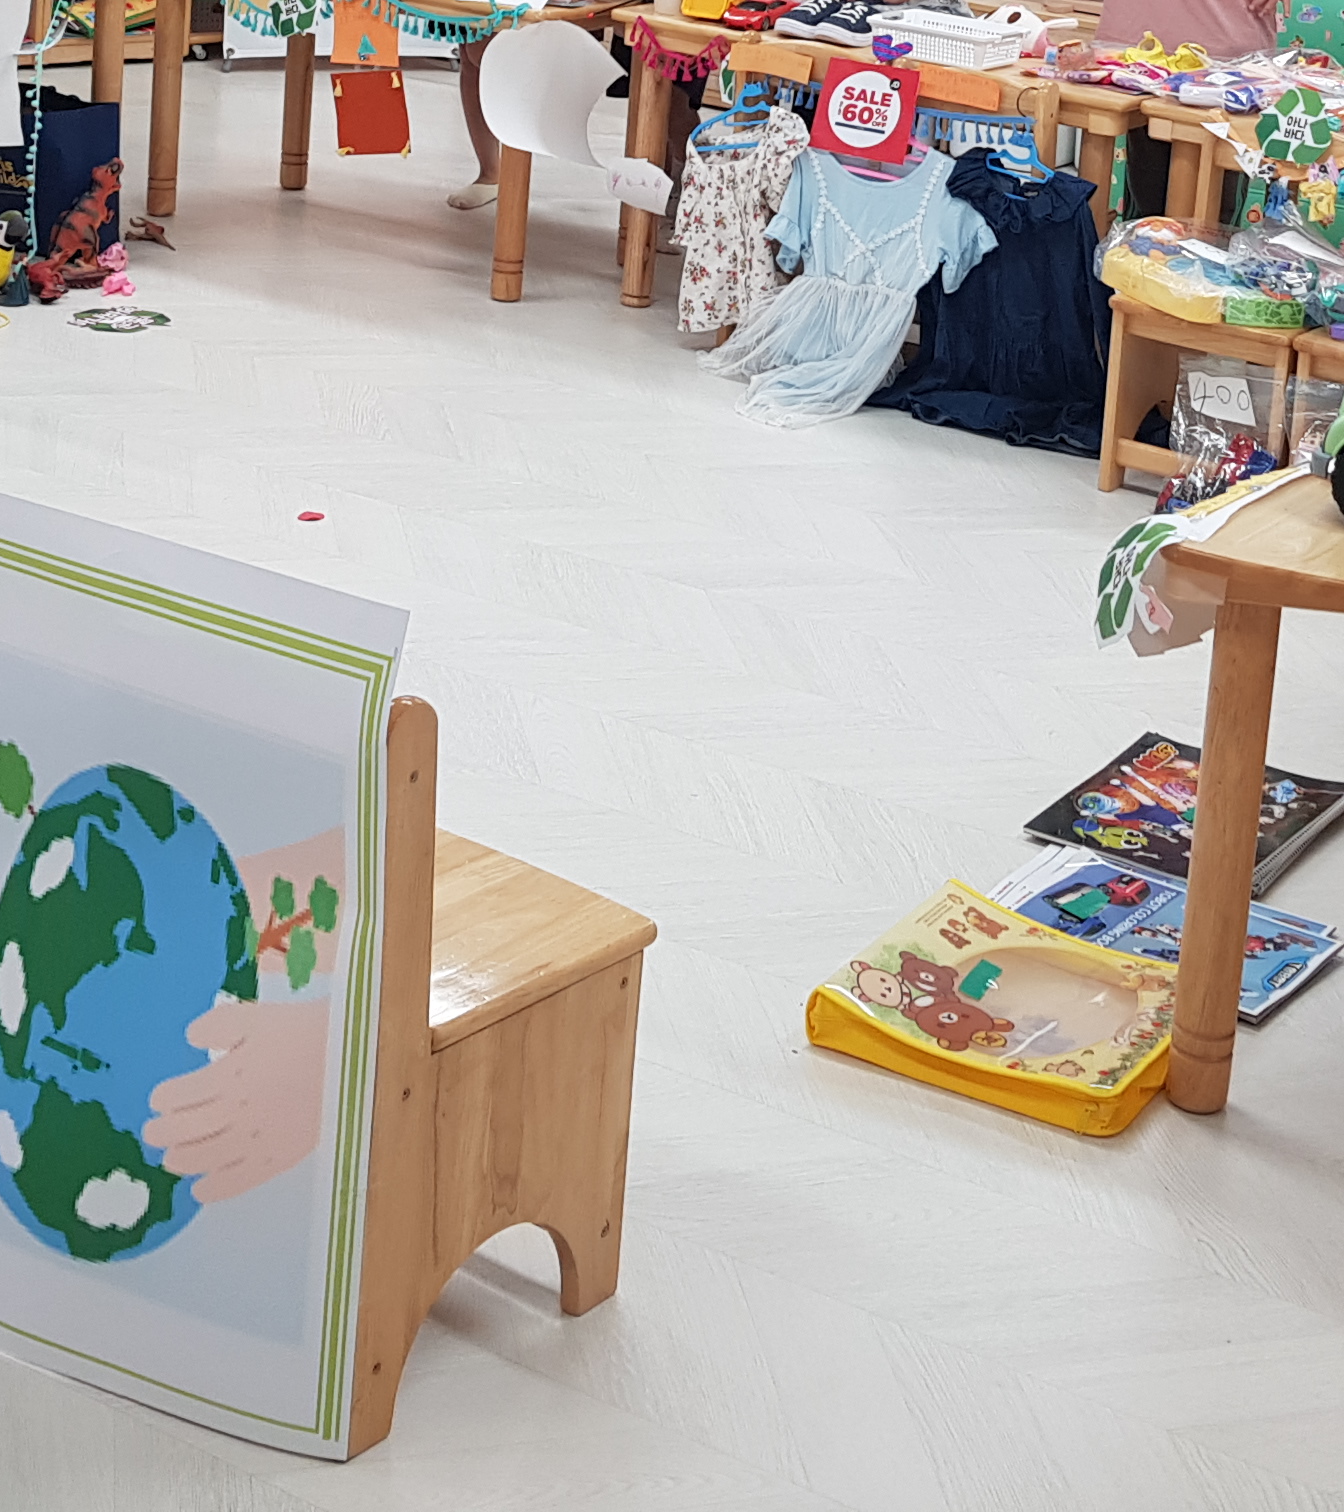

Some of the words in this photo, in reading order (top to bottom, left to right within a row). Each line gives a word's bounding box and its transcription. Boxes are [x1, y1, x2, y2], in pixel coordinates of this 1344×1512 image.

[842, 85, 894, 108] SALE
[842, 102, 889, 125] 60%
[1286, 115, 1309, 130] 아나
[1283, 127, 1305, 141] 바다
[1193, 376, 1250, 413] 400
